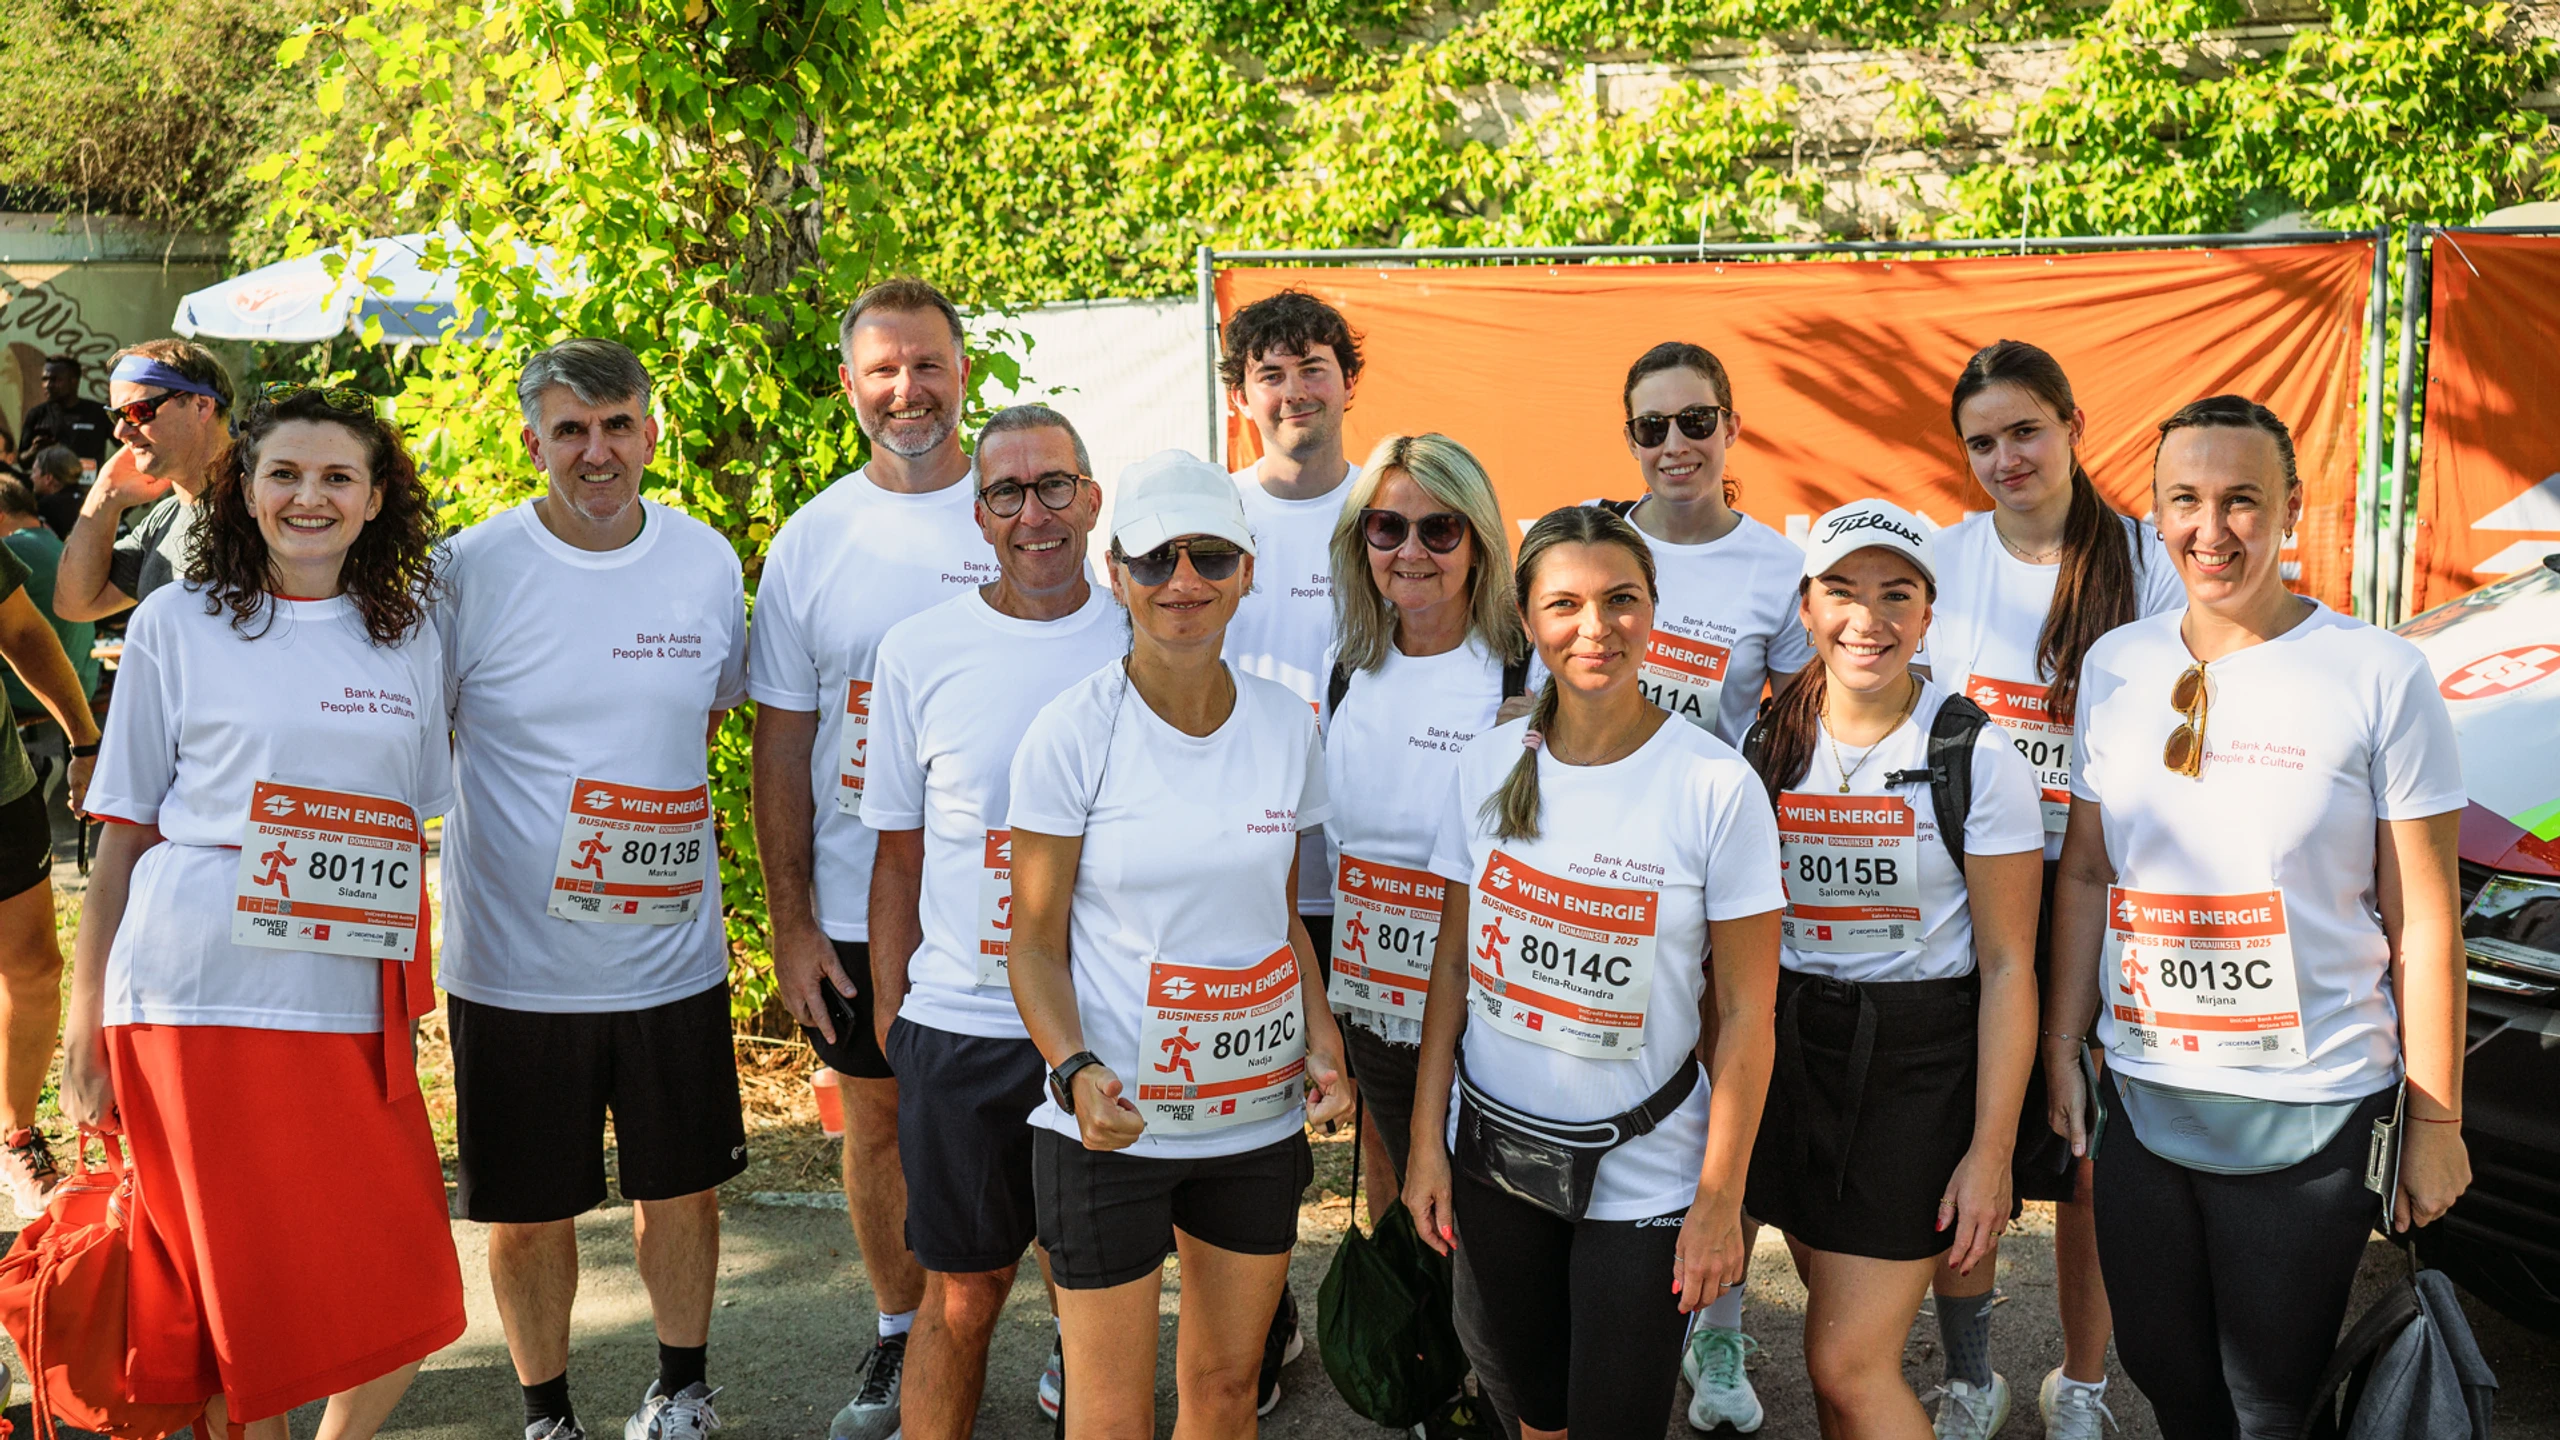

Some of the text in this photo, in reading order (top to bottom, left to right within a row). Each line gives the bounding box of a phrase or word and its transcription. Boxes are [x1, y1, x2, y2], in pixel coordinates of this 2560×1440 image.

[1822, 511, 1923, 546] Titleist
[964, 562, 991, 572] Bank
[942, 574, 989, 585] People &
[1312, 574, 1332, 584] Ban
[1291, 588, 1333, 599] People &
[1683, 616, 1737, 635] Bank Austria
[637, 633, 701, 644] Bank Austria
[1662, 621, 1735, 646] People & Culture
[613, 647, 701, 660] People & Culture
[1656, 643, 1719, 670] ENERGIE
[344, 687, 412, 706] Bank Austria
[1638, 680, 1702, 718] 011A
[321, 702, 415, 720] People & Culture
[1992, 717, 2074, 735] NESS RUN DONAU
[1427, 727, 1475, 741] Bank Aust
[1408, 736, 1438, 750] People
[2232, 740, 2306, 757] Bank Austria
[2014, 739, 2070, 768] 801
[2205, 752, 2304, 771] People & Culture
[2042, 771, 2069, 785] LEG
[620, 798, 705, 815] WIEN ENERGIE
[303, 802, 413, 831] WIEN ENERGIE
[1265, 809, 1286, 819] Bank
[1786, 806, 1904, 825] WIEN ENERGIE
[578, 817, 630, 831] BUSINESS
[634, 824, 655, 833] RUN
[1247, 823, 1280, 834] People
[1282, 823, 1287, 832] &
[1917, 822, 1934, 830] tria
[258, 825, 316, 841] BUSINESS
[319, 833, 343, 843] RUN
[1779, 835, 1800, 844] NESS
[1803, 836, 1824, 845] RUN
[1878, 839, 1900, 847] 2025
[622, 839, 700, 865] 8013B
[309, 852, 409, 889] 8011C
[1594, 853, 1665, 875] Bank Austria
[1800, 855, 1898, 885] 8015B
[648, 869, 678, 877] Markus
[1568, 863, 1664, 887] People & Culture
[1371, 876, 1411, 895] WIEN
[338, 887, 378, 900] Slađana
[1517, 878, 1645, 922] WIEN ENERGIE
[1819, 888, 1880, 898] Salome Ayla
[568, 895, 601, 906] POWER
[581, 903, 599, 912] ADE
[1344, 894, 1381, 912] BUSINESS
[1384, 906, 1406, 916] RUN
[252, 918, 288, 929] POWER
[1482, 895, 1528, 921] BUSINESS
[1530, 915, 1554, 930] RUN
[1614, 936, 1639, 947] 2025
[2142, 907, 2272, 926] WIEN ENERGIE
[267, 928, 287, 937] ADE
[300, 927, 312, 936] AK
[1806, 928, 1815, 936] AK
[2116, 932, 2271, 950] BUSINESS RUN DONAUINSEL 2025
[1407, 959, 1431, 972] Margi
[1520, 934, 1632, 987] 8014C
[1204, 960, 1294, 999] WIEN ENERGIE
[2160, 959, 2273, 990] 8013C
[1344, 979, 1370, 991] POWER
[1532, 970, 1614, 1001] Elena-Ruxandra
[1355, 990, 1370, 1000] ADE
[1479, 989, 1503, 1009] POWER
[2197, 995, 2237, 1007] Mirjana
[1157, 1010, 1219, 1022] BUSINESS
[1223, 1010, 1247, 1022] RUN
[1514, 1012, 1525, 1022] AK
[1213, 1011, 1296, 1060] 8012C
[2130, 1027, 2157, 1039] POWER
[1248, 1055, 1272, 1067] Nadja
[1156, 1104, 1195, 1113] POWER
[1207, 1106, 1219, 1114] AK
[1173, 1112, 1194, 1121] ADE
[1652, 1218, 1685, 1227] asics
